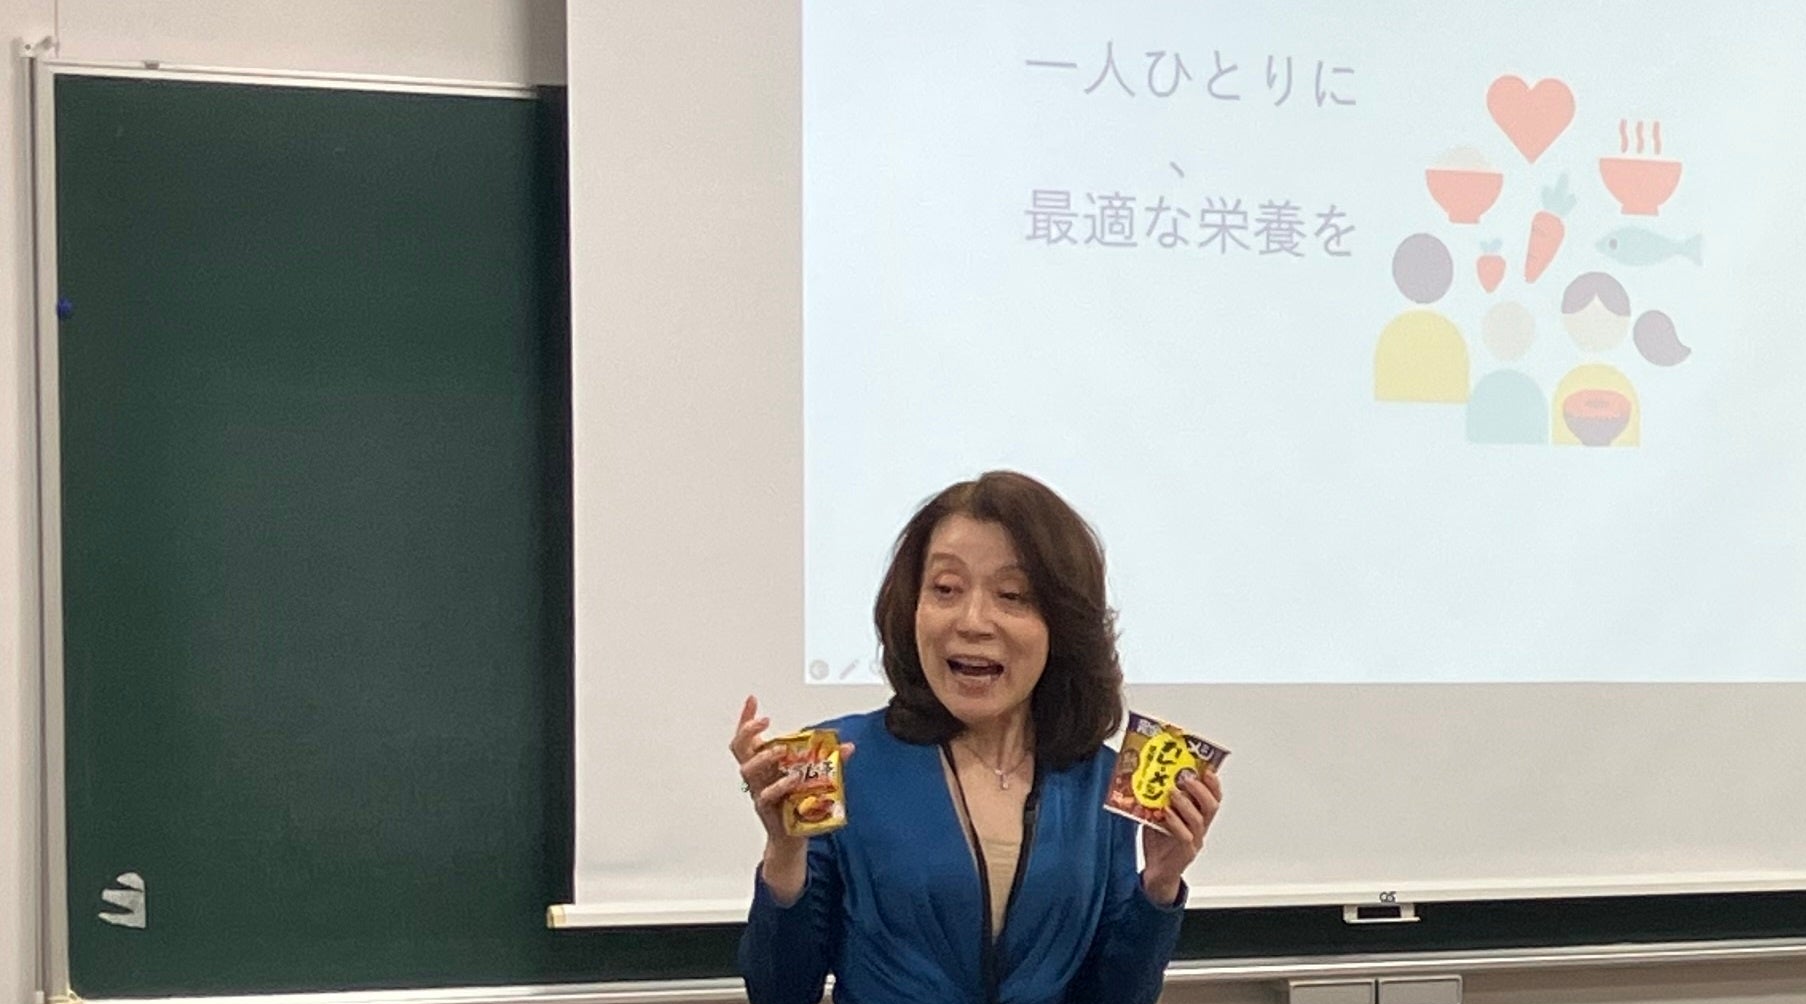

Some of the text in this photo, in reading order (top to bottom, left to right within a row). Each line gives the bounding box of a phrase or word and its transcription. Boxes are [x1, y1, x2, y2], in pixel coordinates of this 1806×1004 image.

[1025, 41, 1357, 107] 一人ひとりに
[1024, 189, 1357, 258] 最適な栄養を
